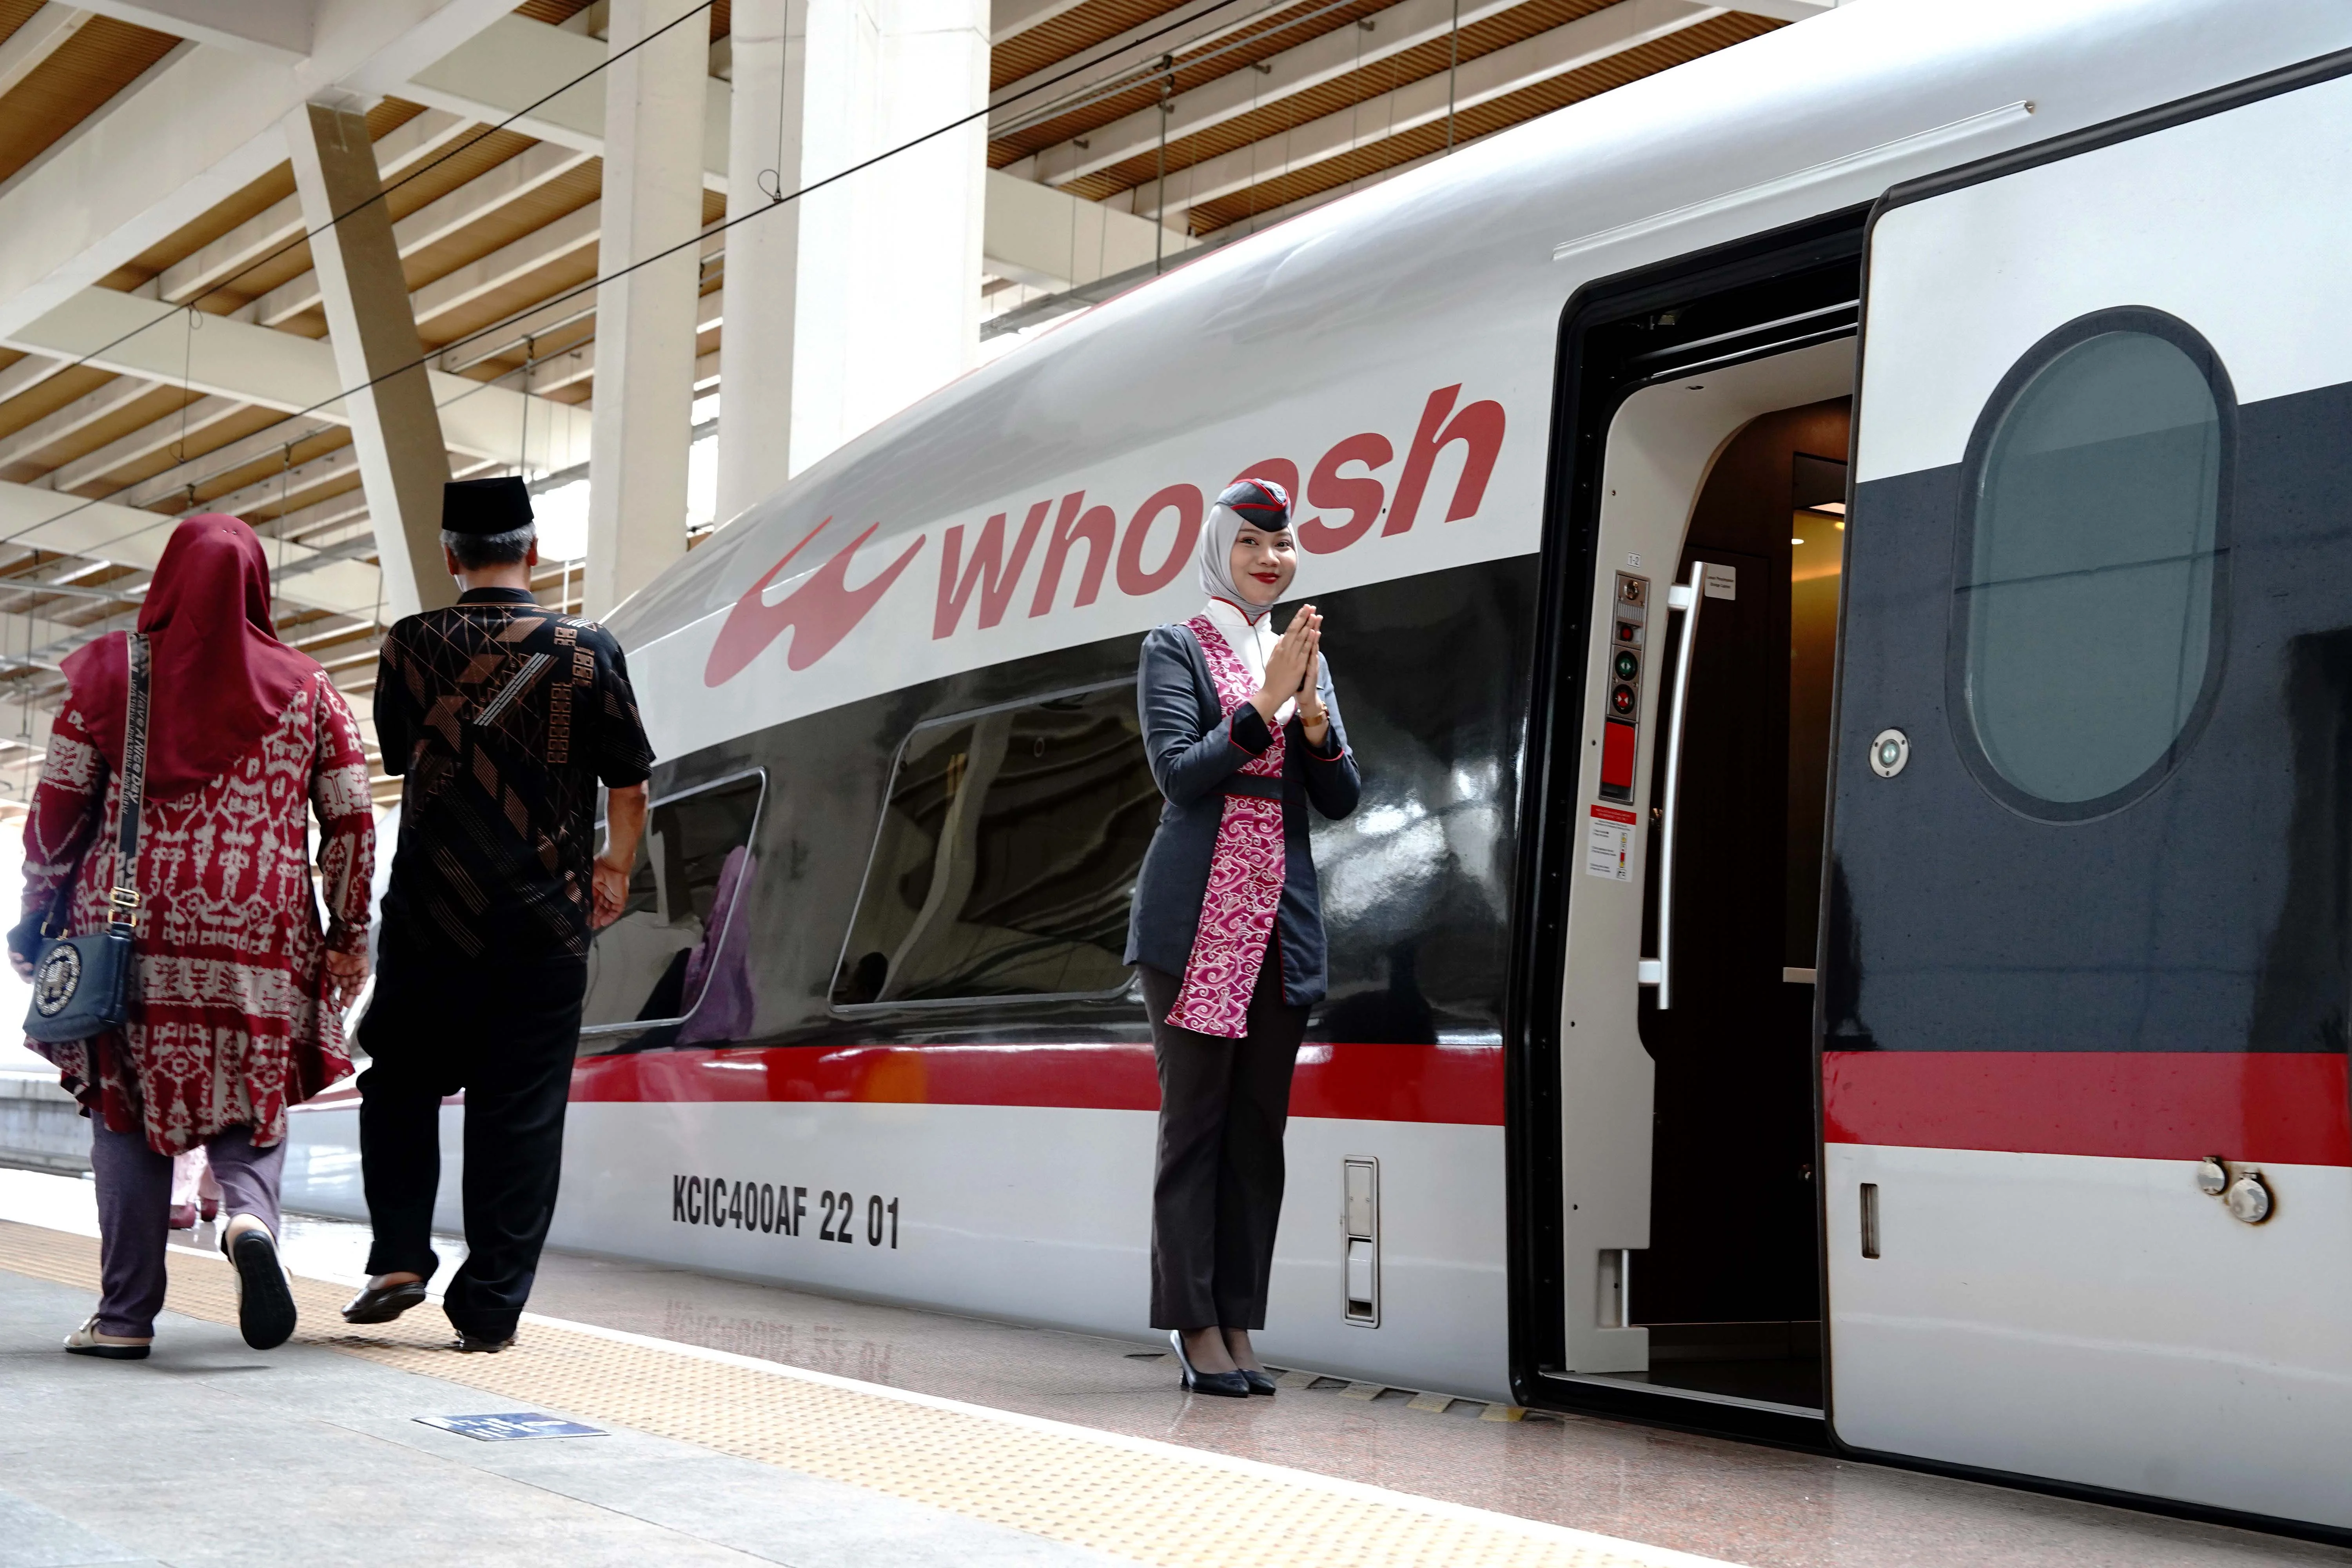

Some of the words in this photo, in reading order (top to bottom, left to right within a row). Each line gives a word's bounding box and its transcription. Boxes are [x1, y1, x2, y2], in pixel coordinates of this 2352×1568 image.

[1629, 555, 1639, 565] 1-2
[129, 773, 142, 804] Day
[673, 1174, 807, 1237] KCIC400AF
[819, 1190, 853, 1244] 22
[867, 1195, 898, 1249] 01
